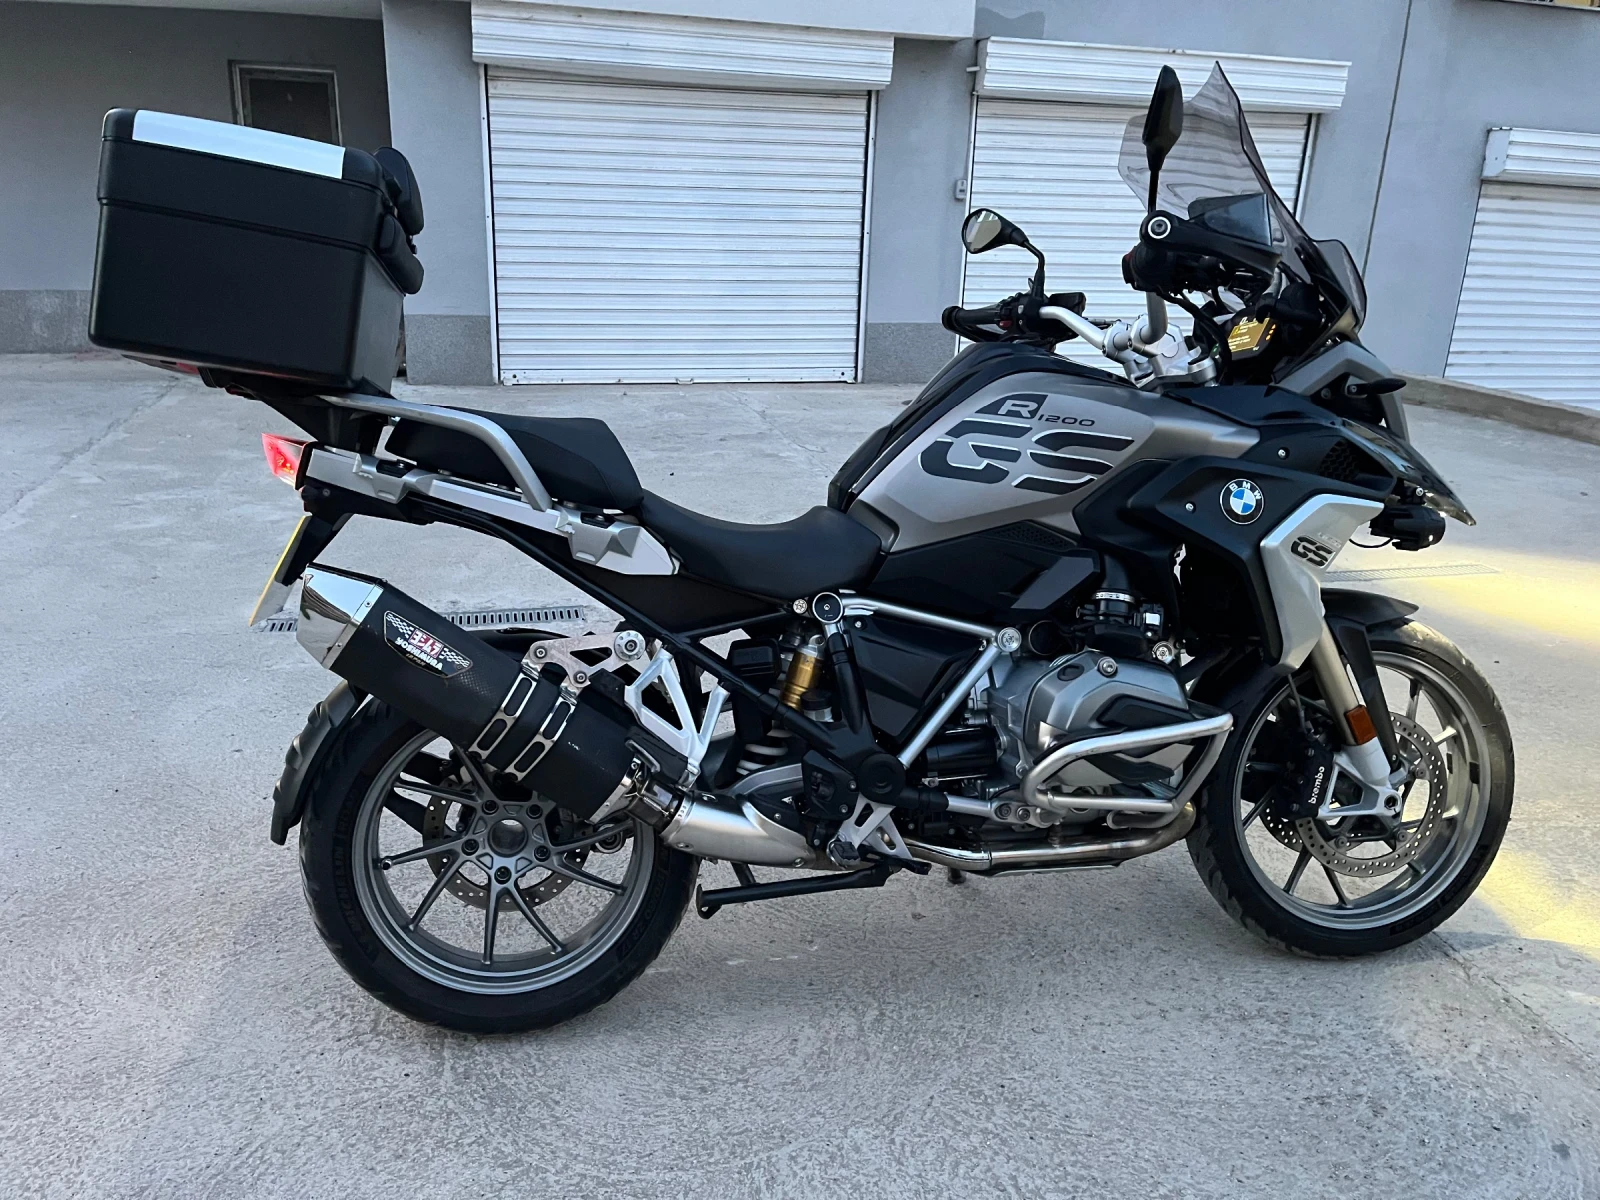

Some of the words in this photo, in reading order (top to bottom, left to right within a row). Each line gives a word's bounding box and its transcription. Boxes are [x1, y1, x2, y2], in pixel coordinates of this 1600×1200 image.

[998, 400, 1038, 418] R
[1038, 415, 1095, 426] 1200
[918, 418, 1135, 496] GS
[1228, 481, 1261, 500] BMW
[1291, 536, 1334, 567] GS
[395, 637, 443, 670] YOSHIMURA
[1308, 766, 1325, 804] brembo
